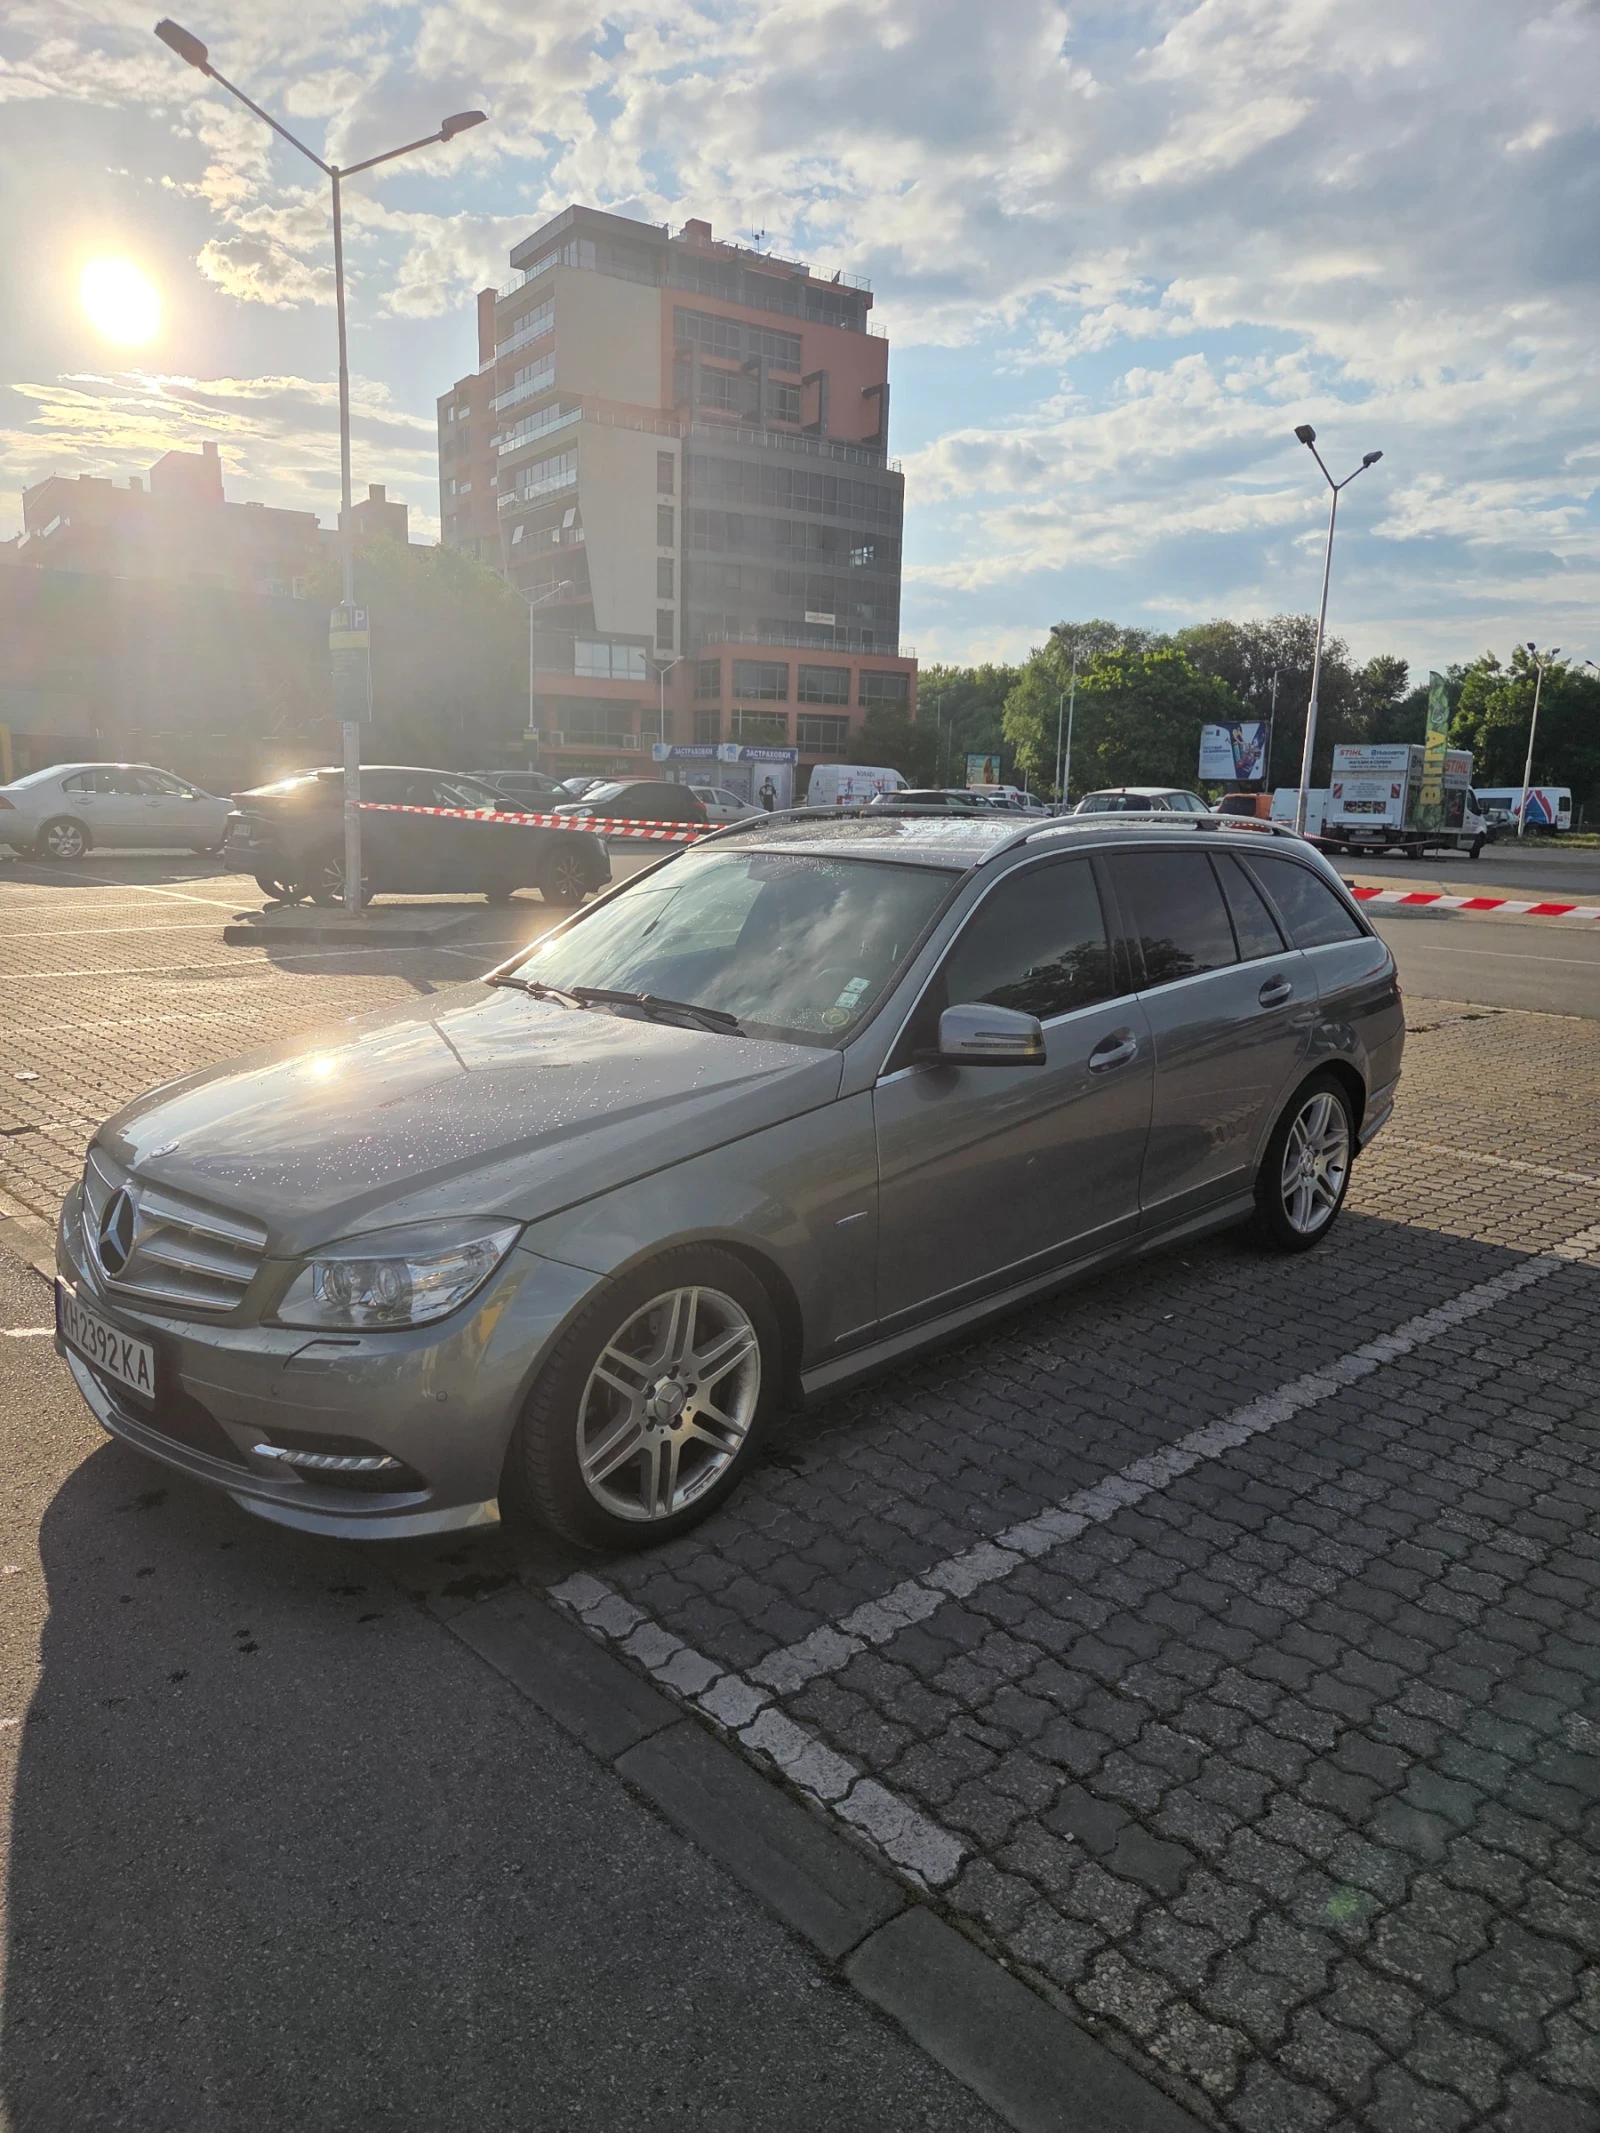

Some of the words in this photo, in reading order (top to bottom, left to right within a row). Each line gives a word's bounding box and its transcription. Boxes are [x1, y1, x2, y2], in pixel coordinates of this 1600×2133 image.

[674, 747, 713, 756] ЗАСТРАХОВКИ
[745, 750, 791, 759] ЗАСТРАХОВКИ
[1445, 759, 1468, 774] STIHL
